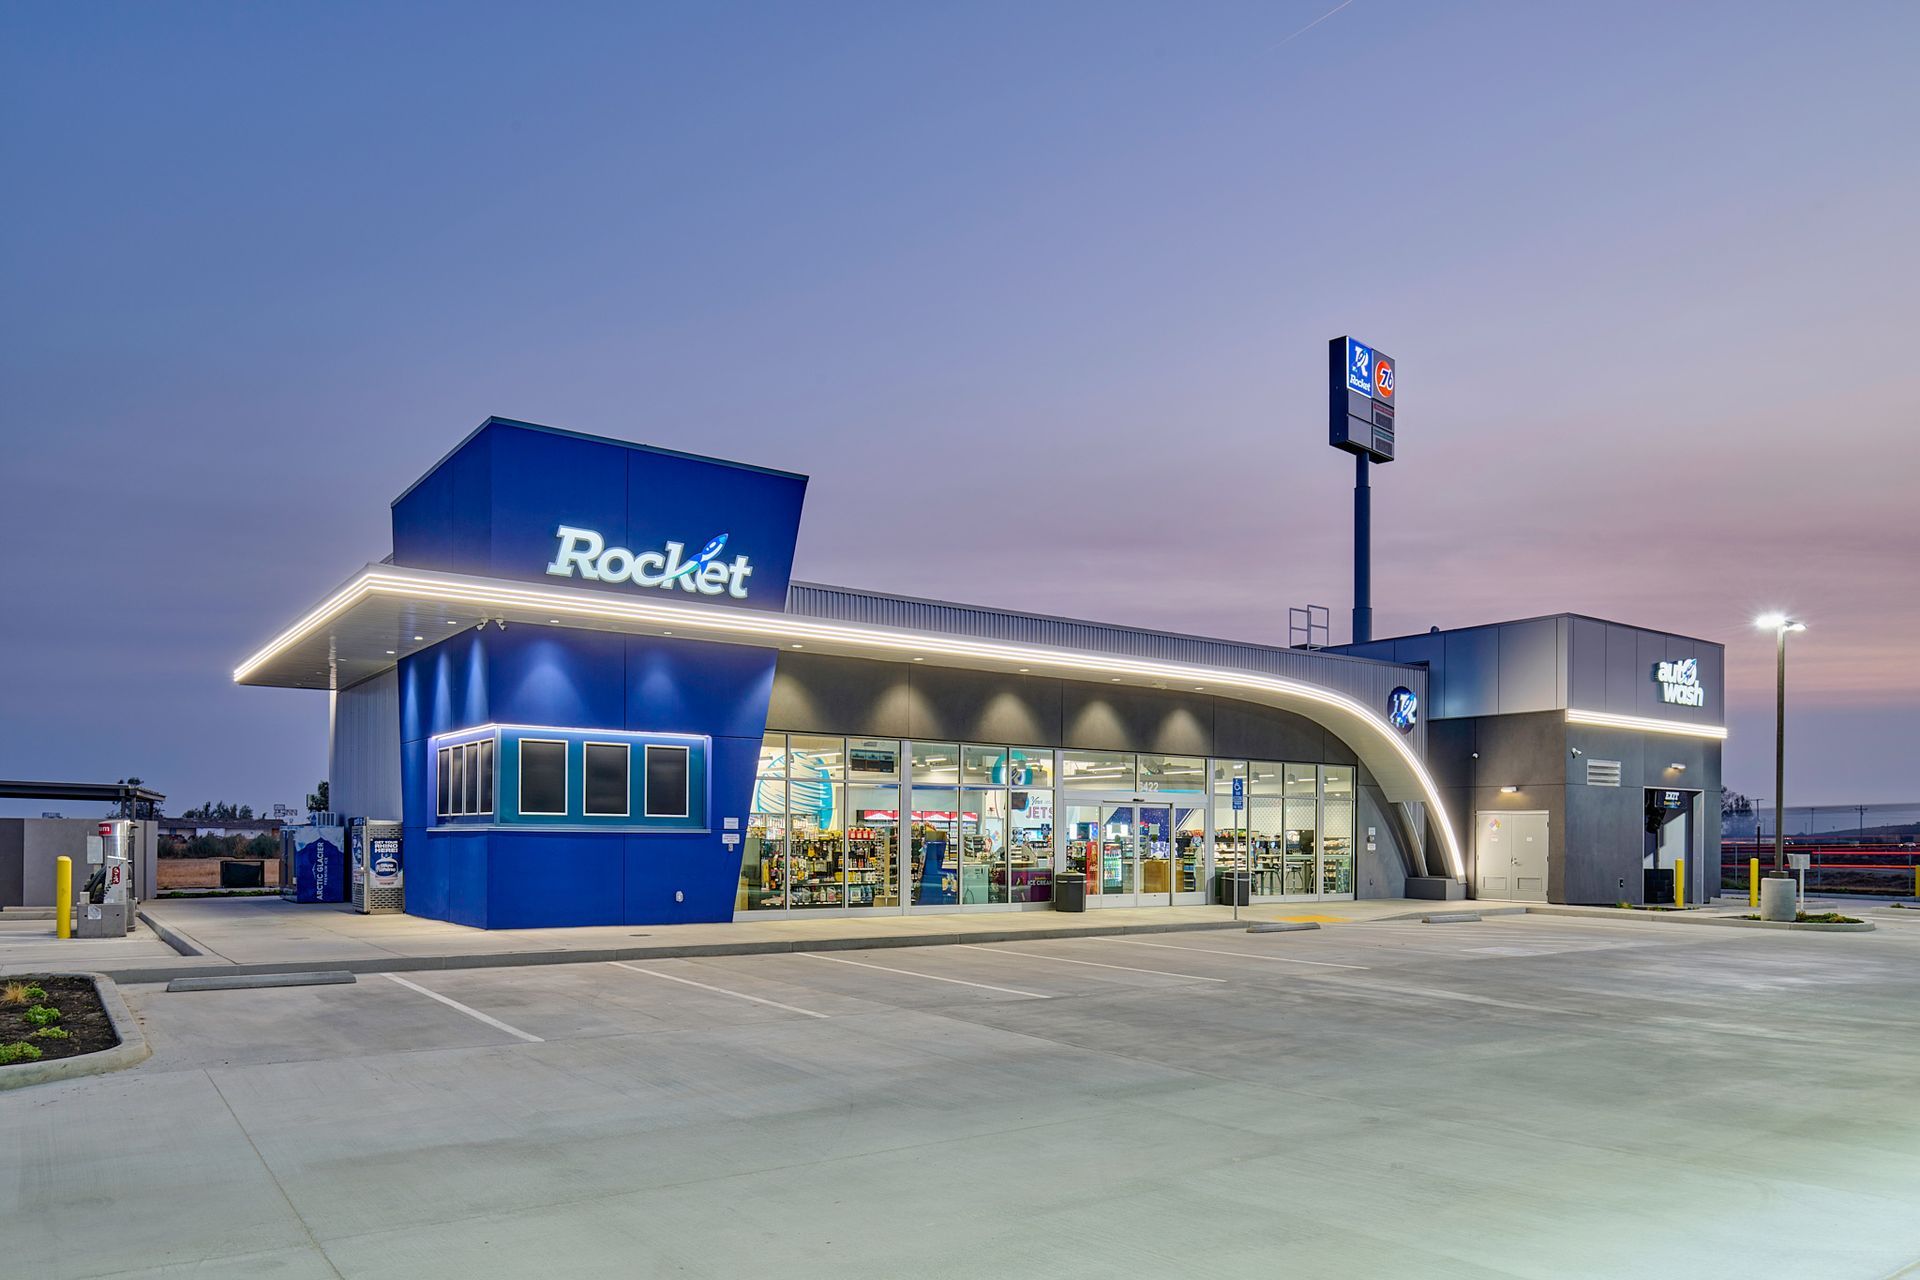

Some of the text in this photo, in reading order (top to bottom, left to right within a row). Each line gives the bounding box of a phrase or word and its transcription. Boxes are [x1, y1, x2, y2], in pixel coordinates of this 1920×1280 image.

[1350, 374, 1370, 391] Rocket
[1379, 368, 1393, 390] 76
[546, 524, 753, 598] Rocket
[1658, 658, 1697, 686] auto
[1663, 680, 1704, 707] wash
[1665, 792, 1679, 800] EXIT
